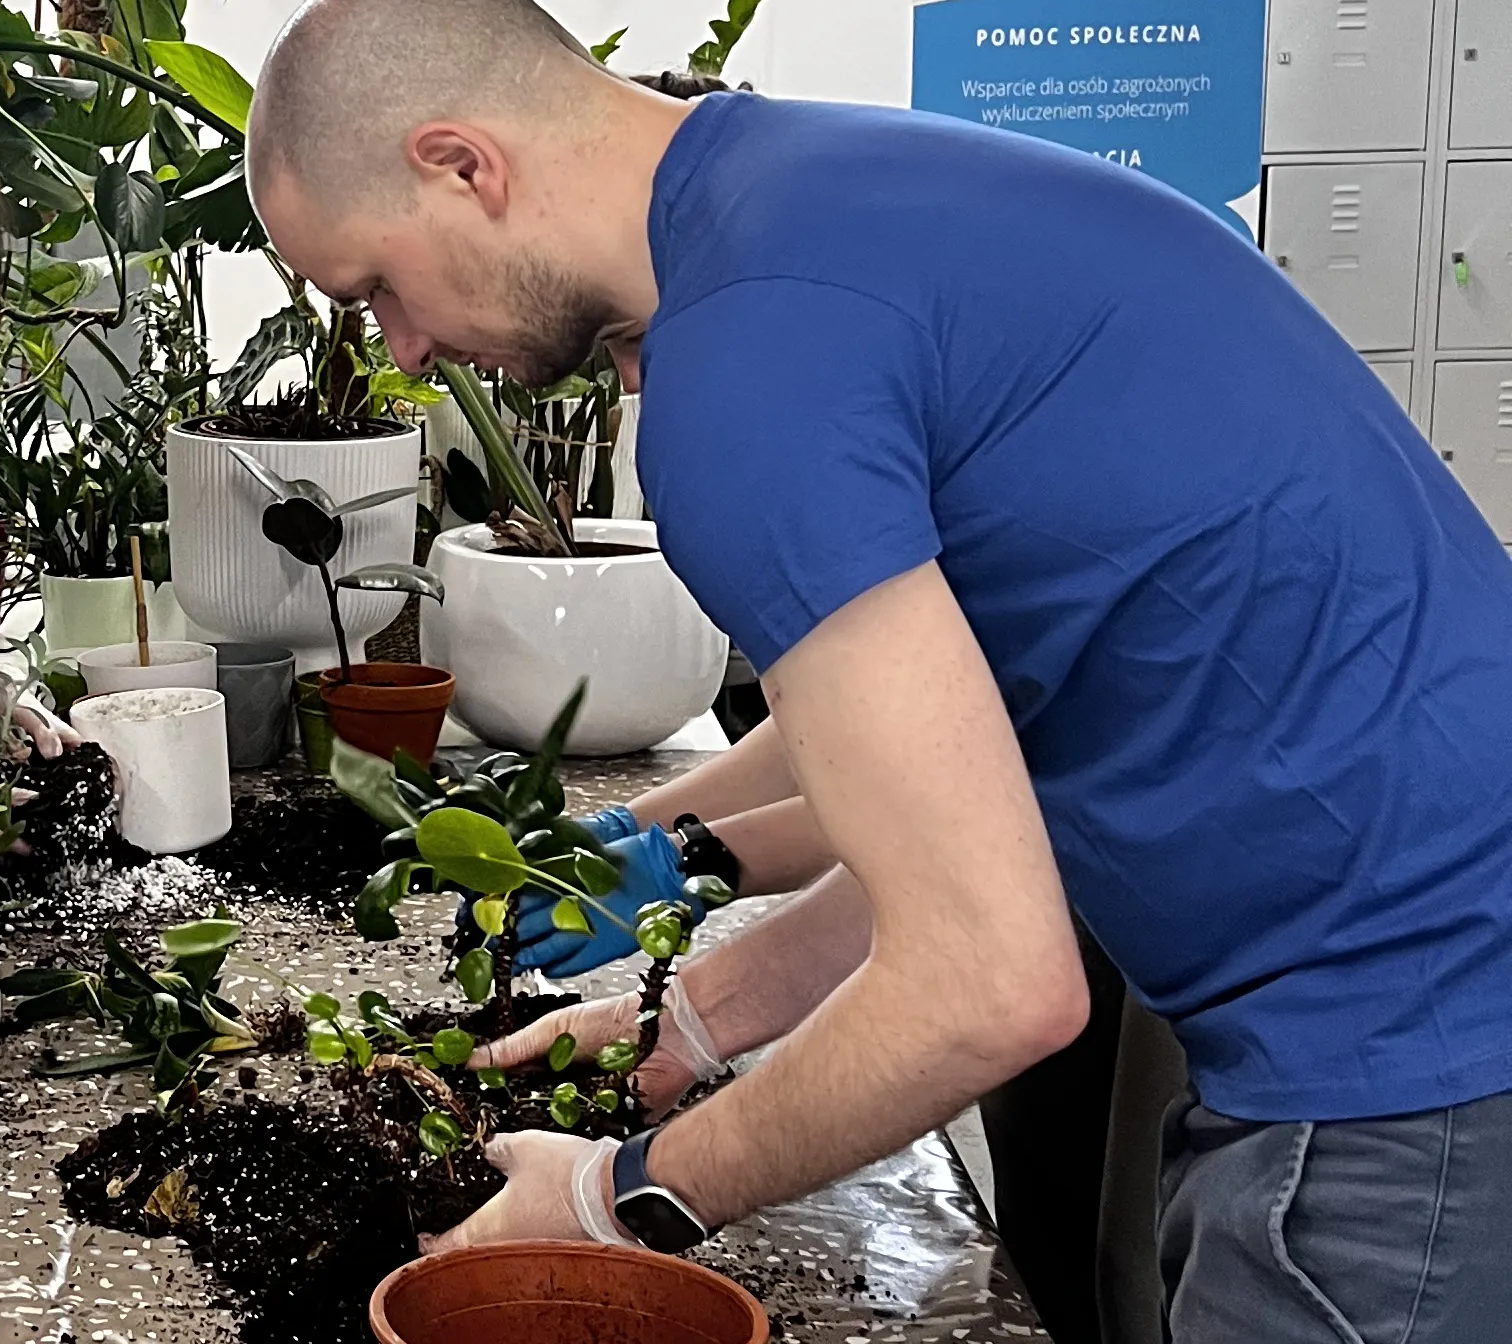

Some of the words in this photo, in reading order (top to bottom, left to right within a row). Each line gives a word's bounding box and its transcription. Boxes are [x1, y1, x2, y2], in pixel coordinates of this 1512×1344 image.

[976, 27, 1059, 47] POMOC
[1070, 24, 1201, 45] SPOŁECZNA
[962, 79, 1035, 101] Wsparcie
[1040, 77, 1064, 96] dla
[1068, 75, 1108, 96] osób
[1112, 73, 1211, 98] zagrożonych
[982, 102, 1092, 127] wykluczeniem
[1097, 100, 1190, 123] społecznym
